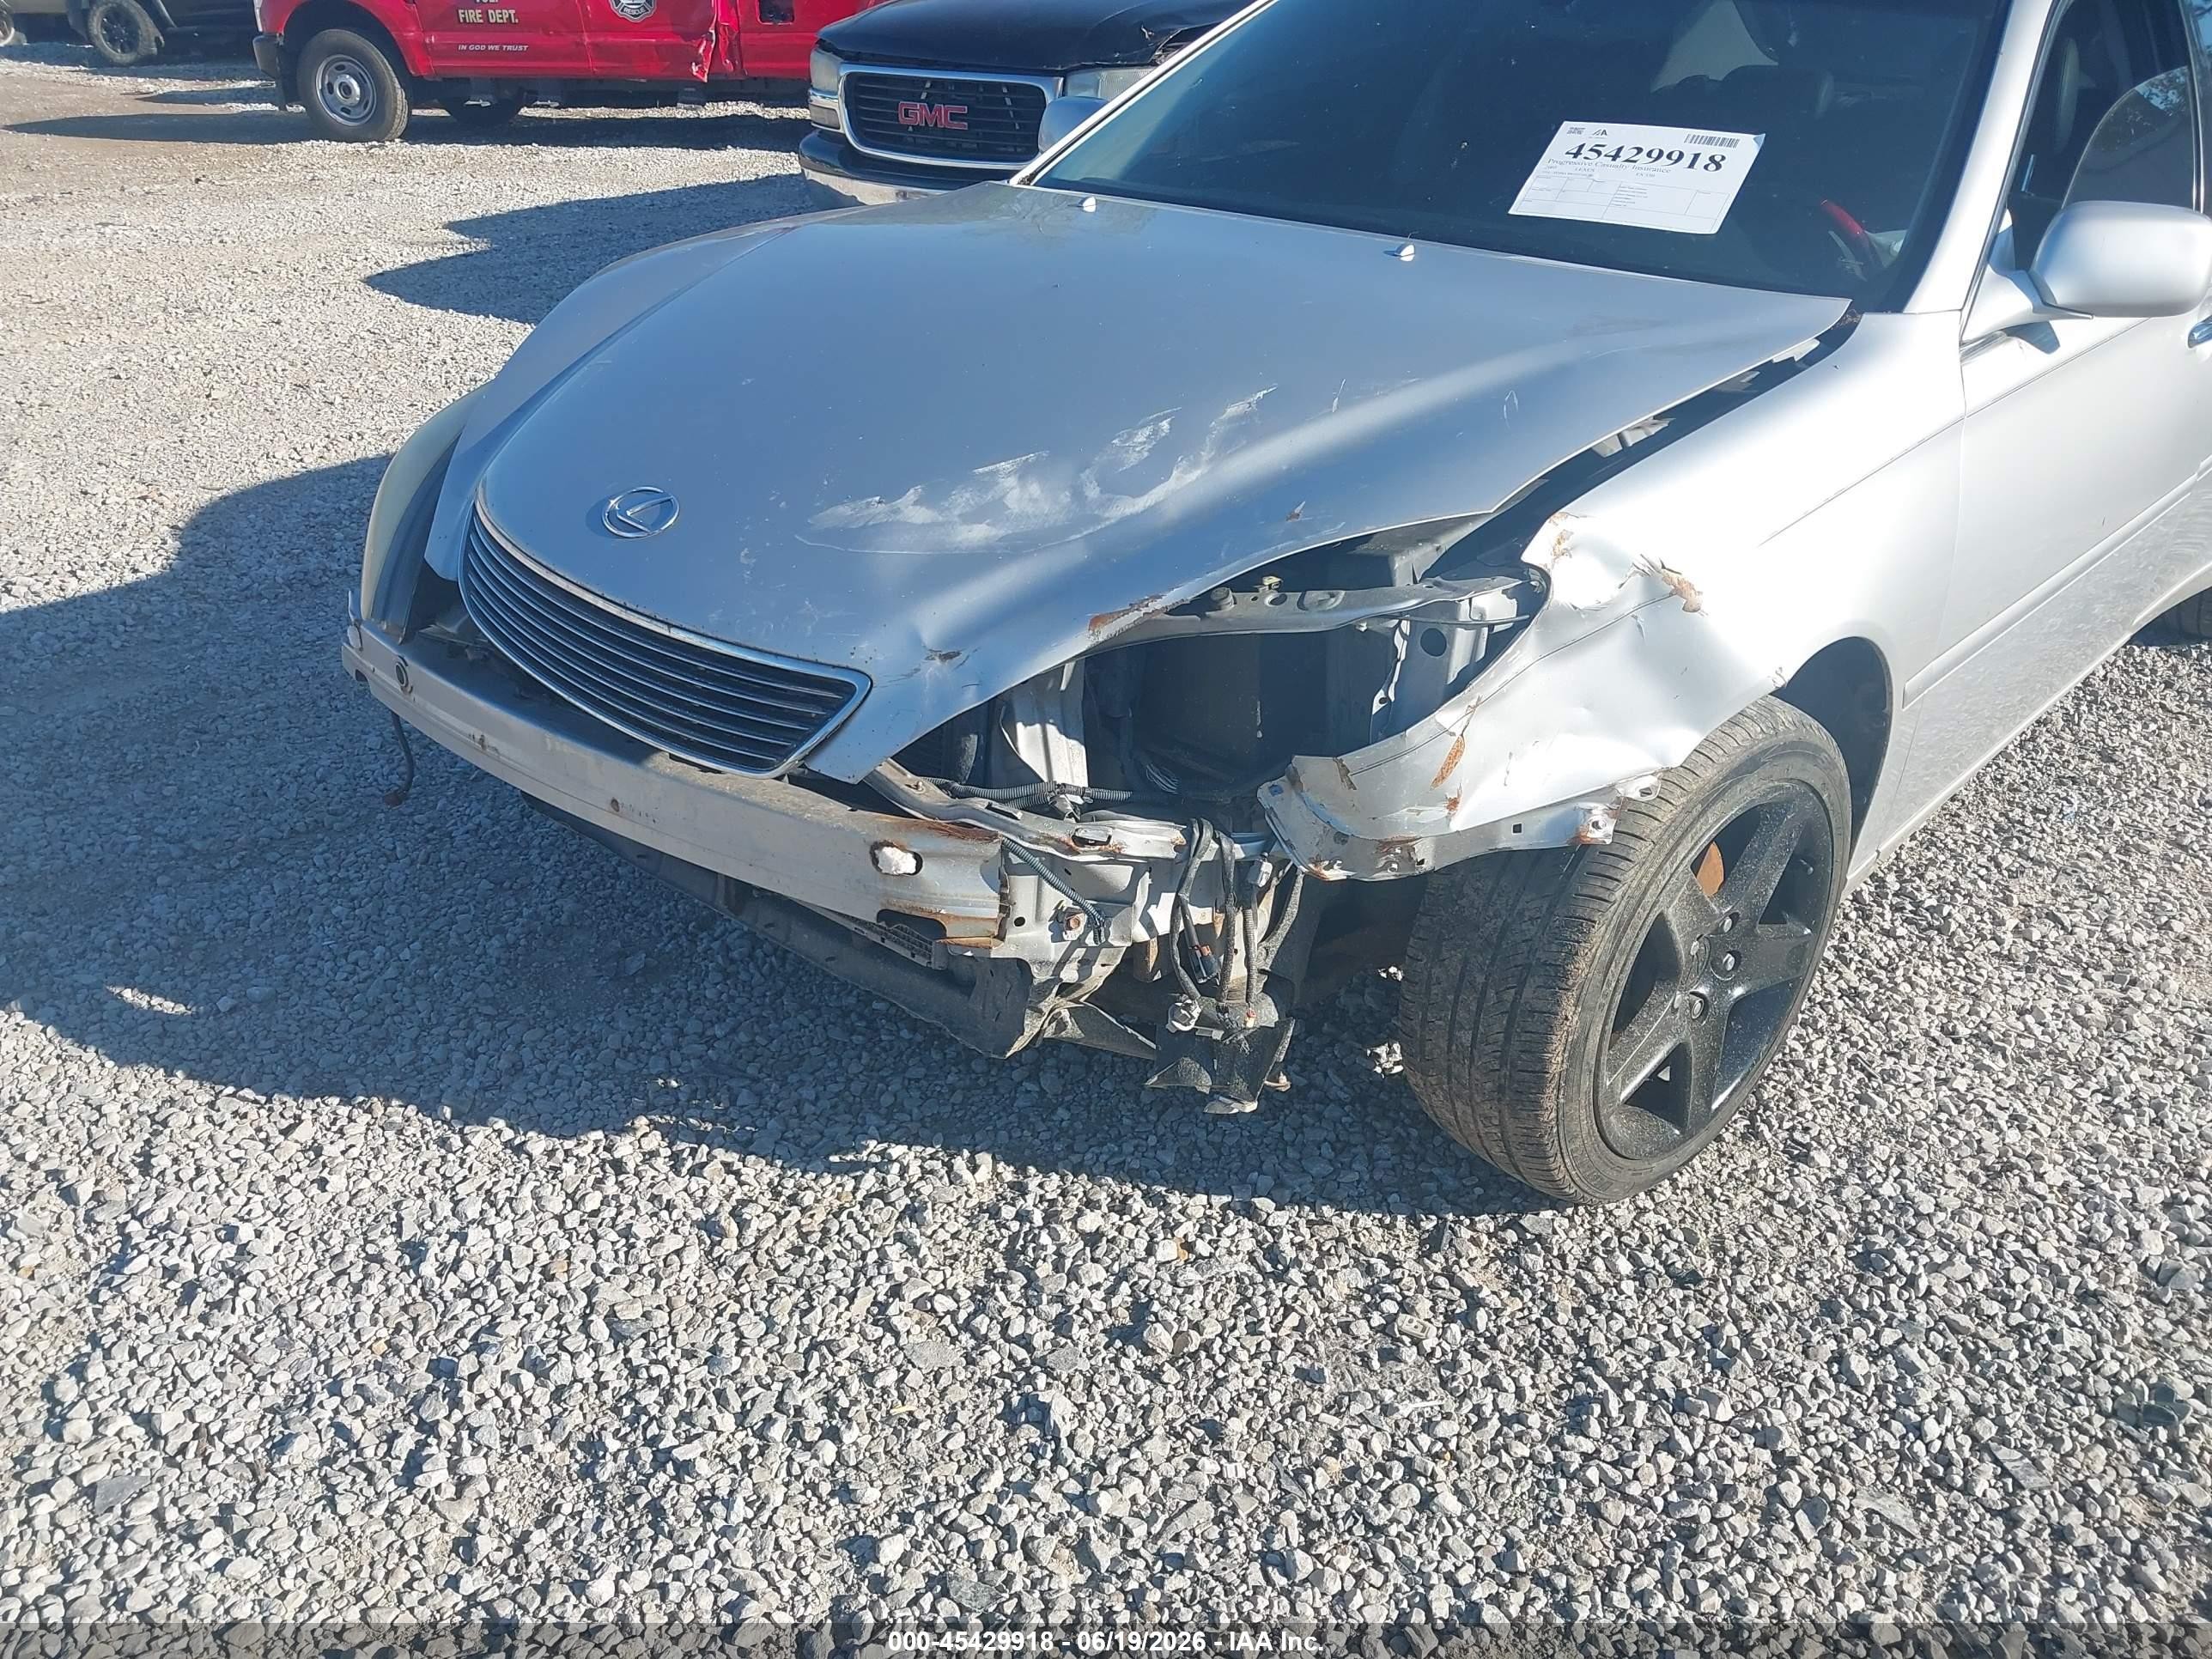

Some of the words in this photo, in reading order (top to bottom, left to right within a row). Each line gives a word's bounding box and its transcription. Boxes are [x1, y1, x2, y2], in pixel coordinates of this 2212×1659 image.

[458, 9, 483, 24] FIRE
[488, 9, 519, 24] DEPT.
[623, 7, 647, 15] RESCUE
[898, 100, 969, 131] GMC
[1565, 142, 1727, 173] 45429918
[1547, 158, 1594, 168] Progressive
[1595, 161, 1629, 171] Casualty
[1631, 164, 1671, 173] Insurance
